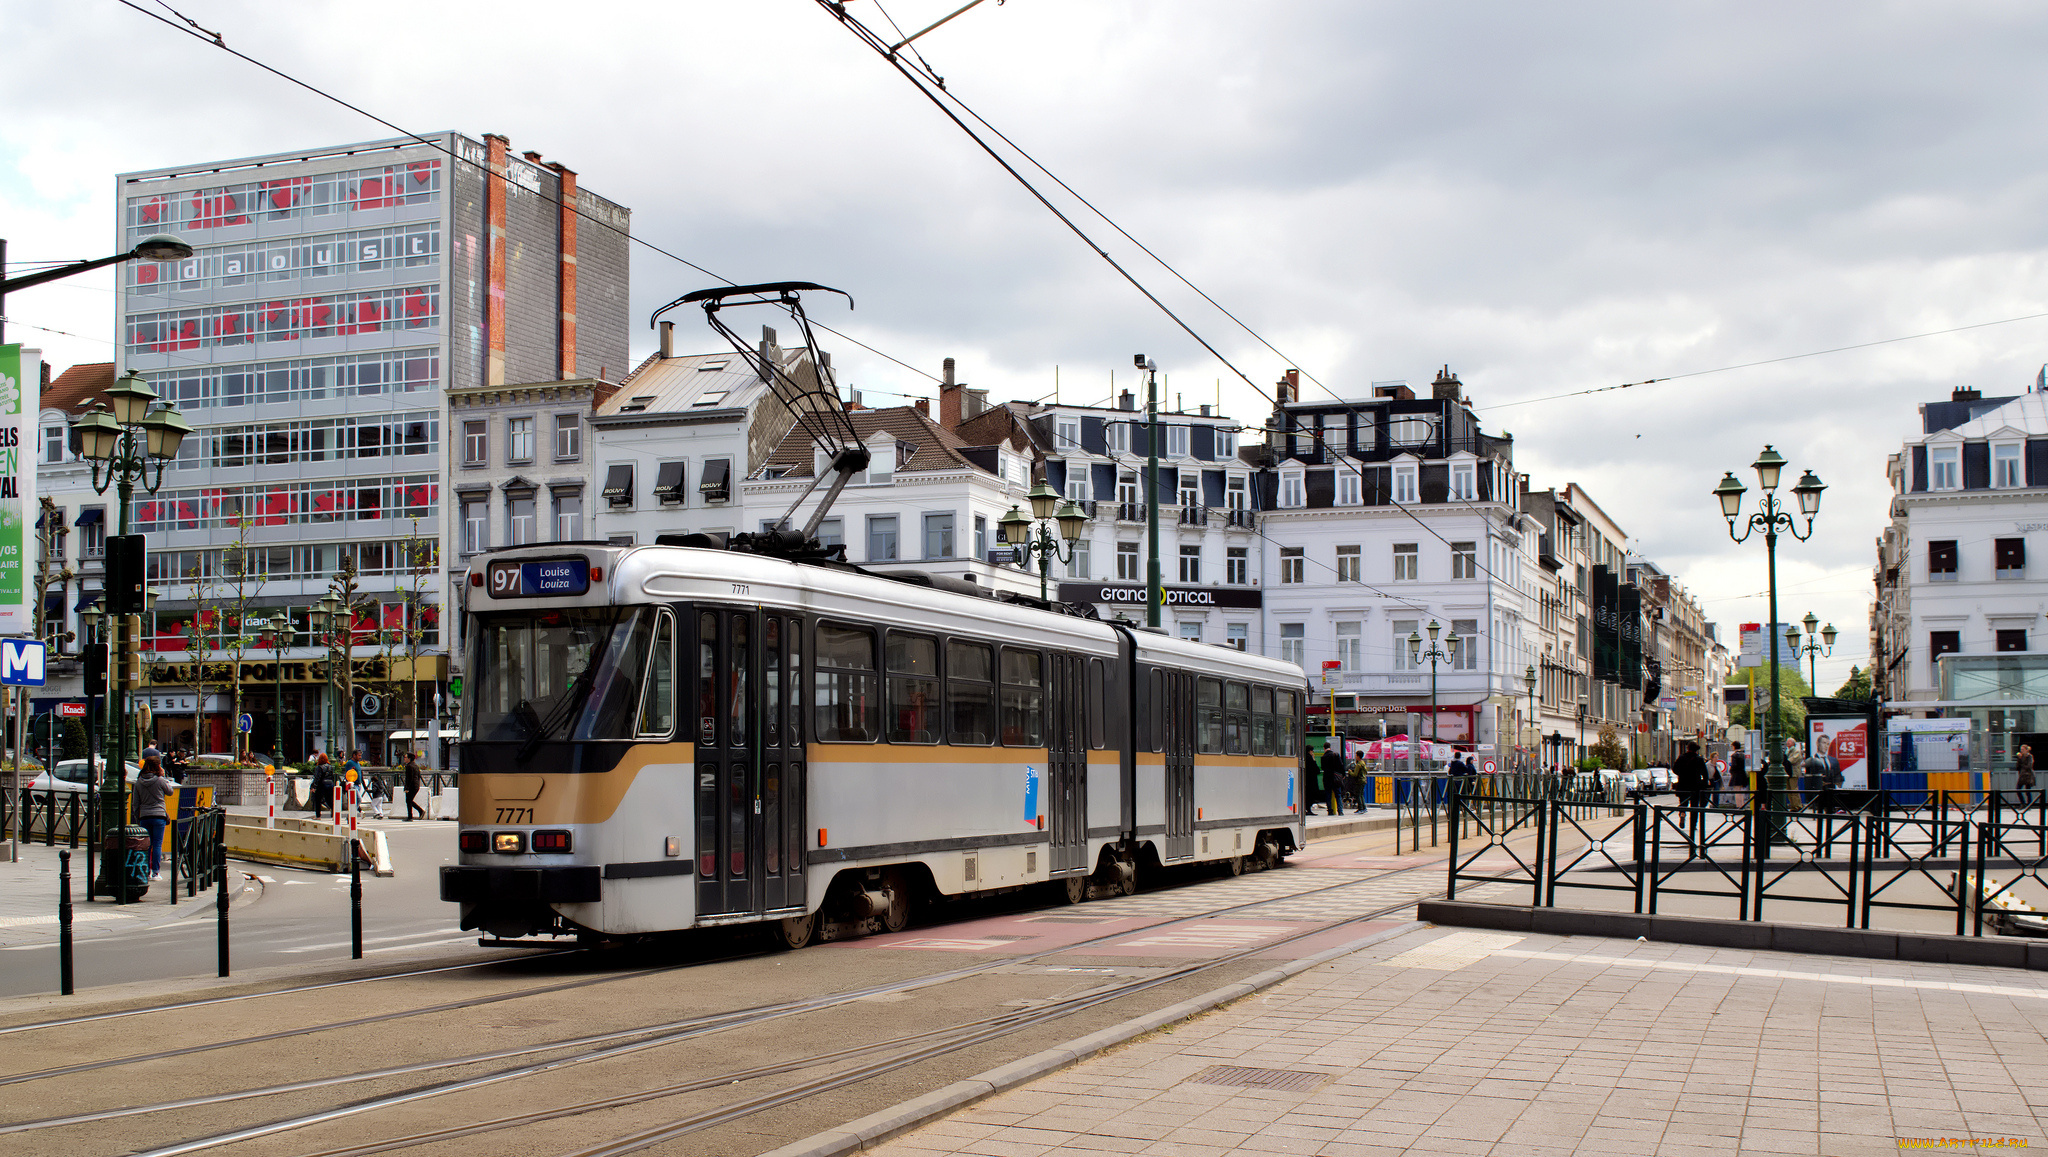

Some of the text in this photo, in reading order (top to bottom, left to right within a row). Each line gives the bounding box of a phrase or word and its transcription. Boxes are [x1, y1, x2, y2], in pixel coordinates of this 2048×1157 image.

[183, 236, 424, 279] daoust
[0, 476, 19, 499] AL
[0, 560, 19, 569] AIRE
[494, 567, 570, 591] 97 Louise
[540, 579, 570, 589] Louiza
[732, 583, 750, 595] 7771
[2, 642, 44, 680] M
[239, 661, 306, 681] PORTE
[64, 706, 86, 714] Knack
[1839, 742, 1855, 752] 43
[495, 807, 534, 824] 7771
